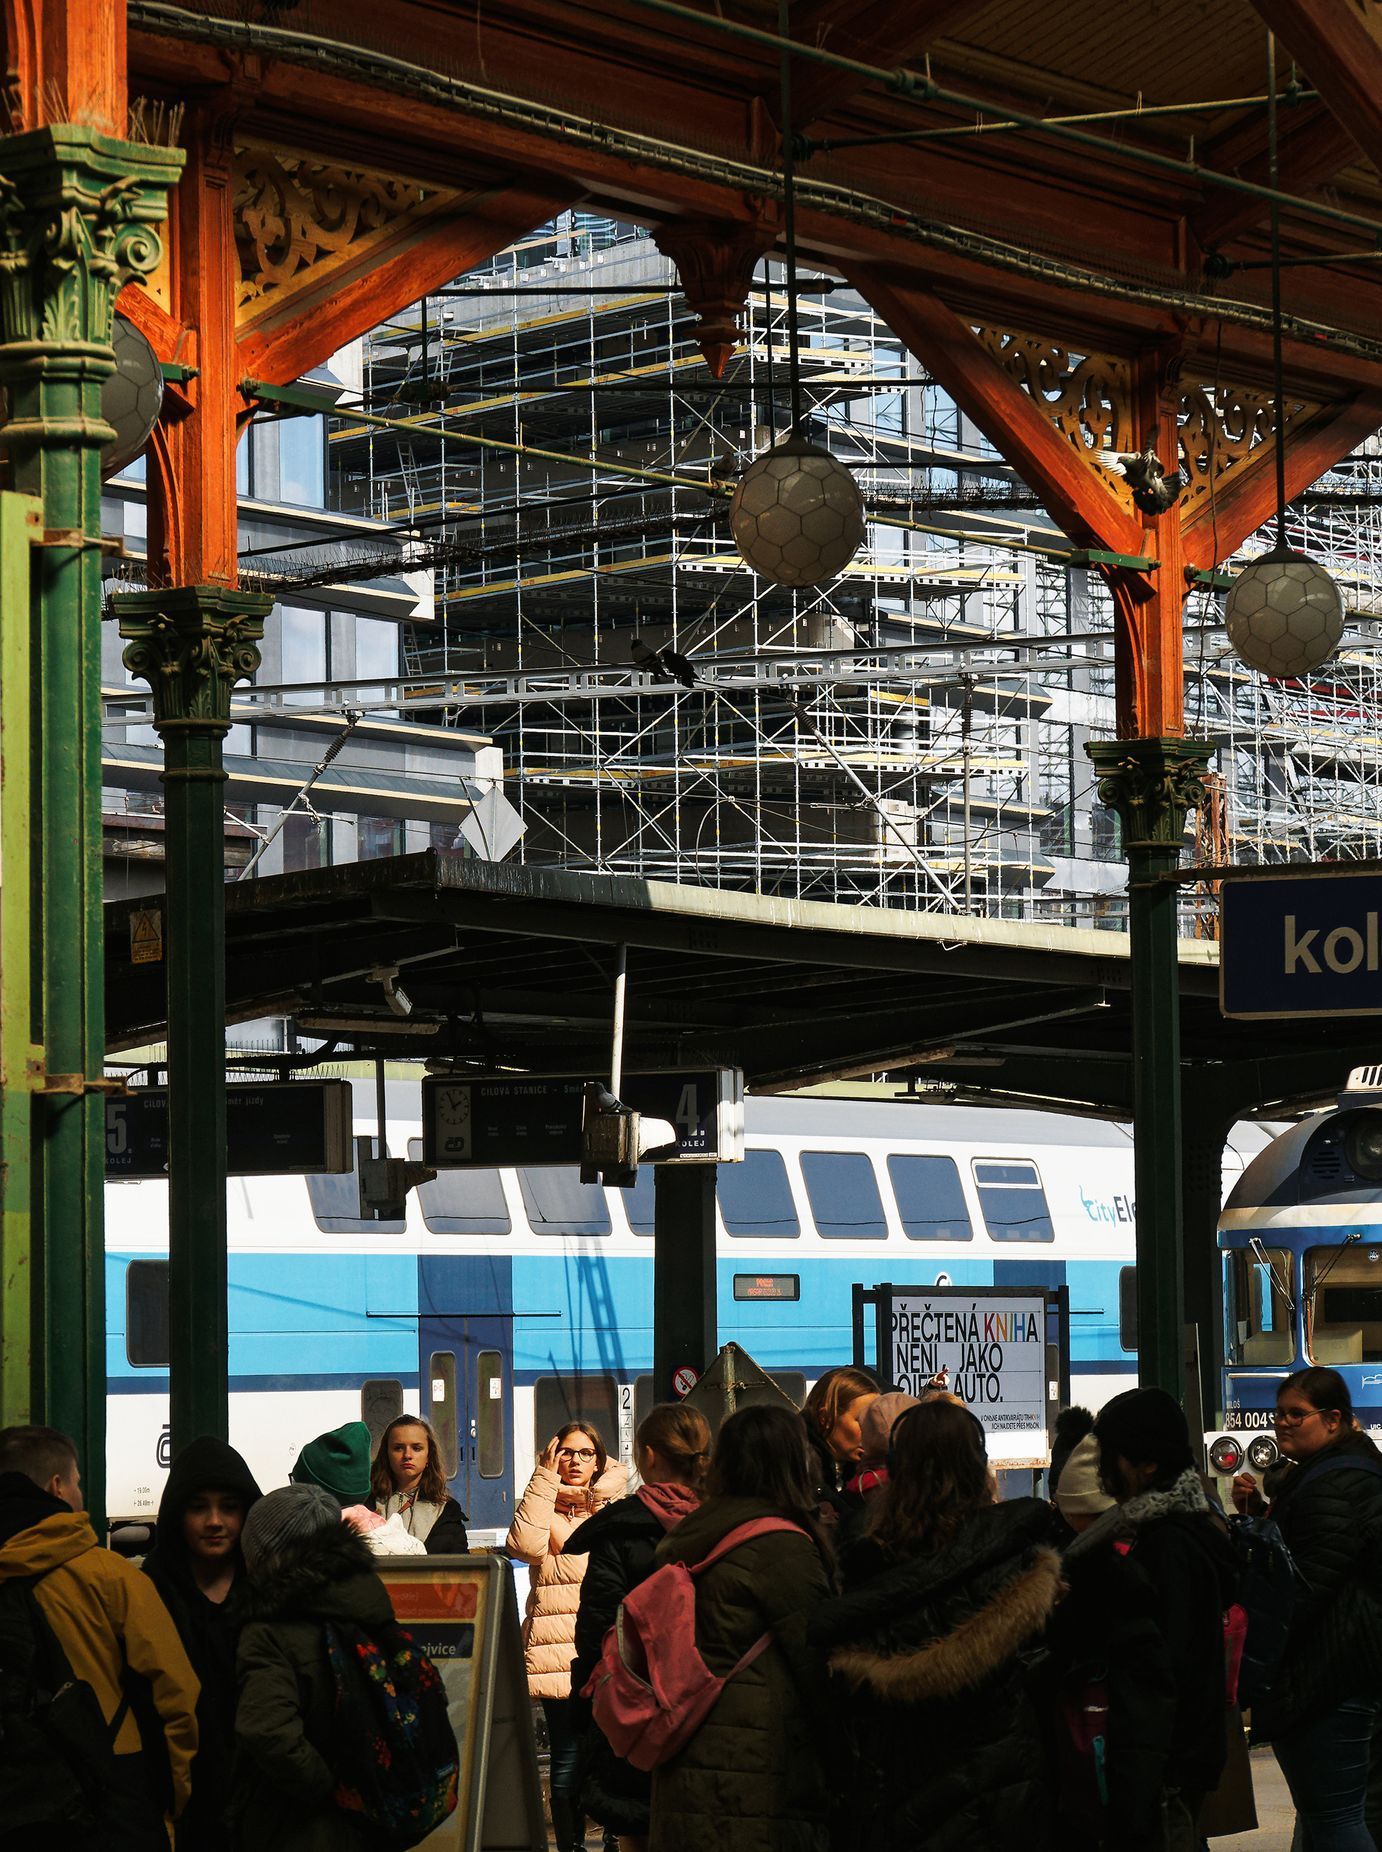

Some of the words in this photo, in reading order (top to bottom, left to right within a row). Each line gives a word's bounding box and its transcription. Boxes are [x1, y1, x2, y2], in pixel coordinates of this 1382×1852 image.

[1284, 911, 1382, 974] kol
[984, 1312, 1039, 1343] KNIHA
[959, 1342, 1004, 1373] JAKO
[622, 1387, 631, 1410] 2
[953, 1372, 1004, 1403] AUTO.
[1244, 1411, 1268, 1429] 004
[420, 1642, 457, 1658] ejvice
